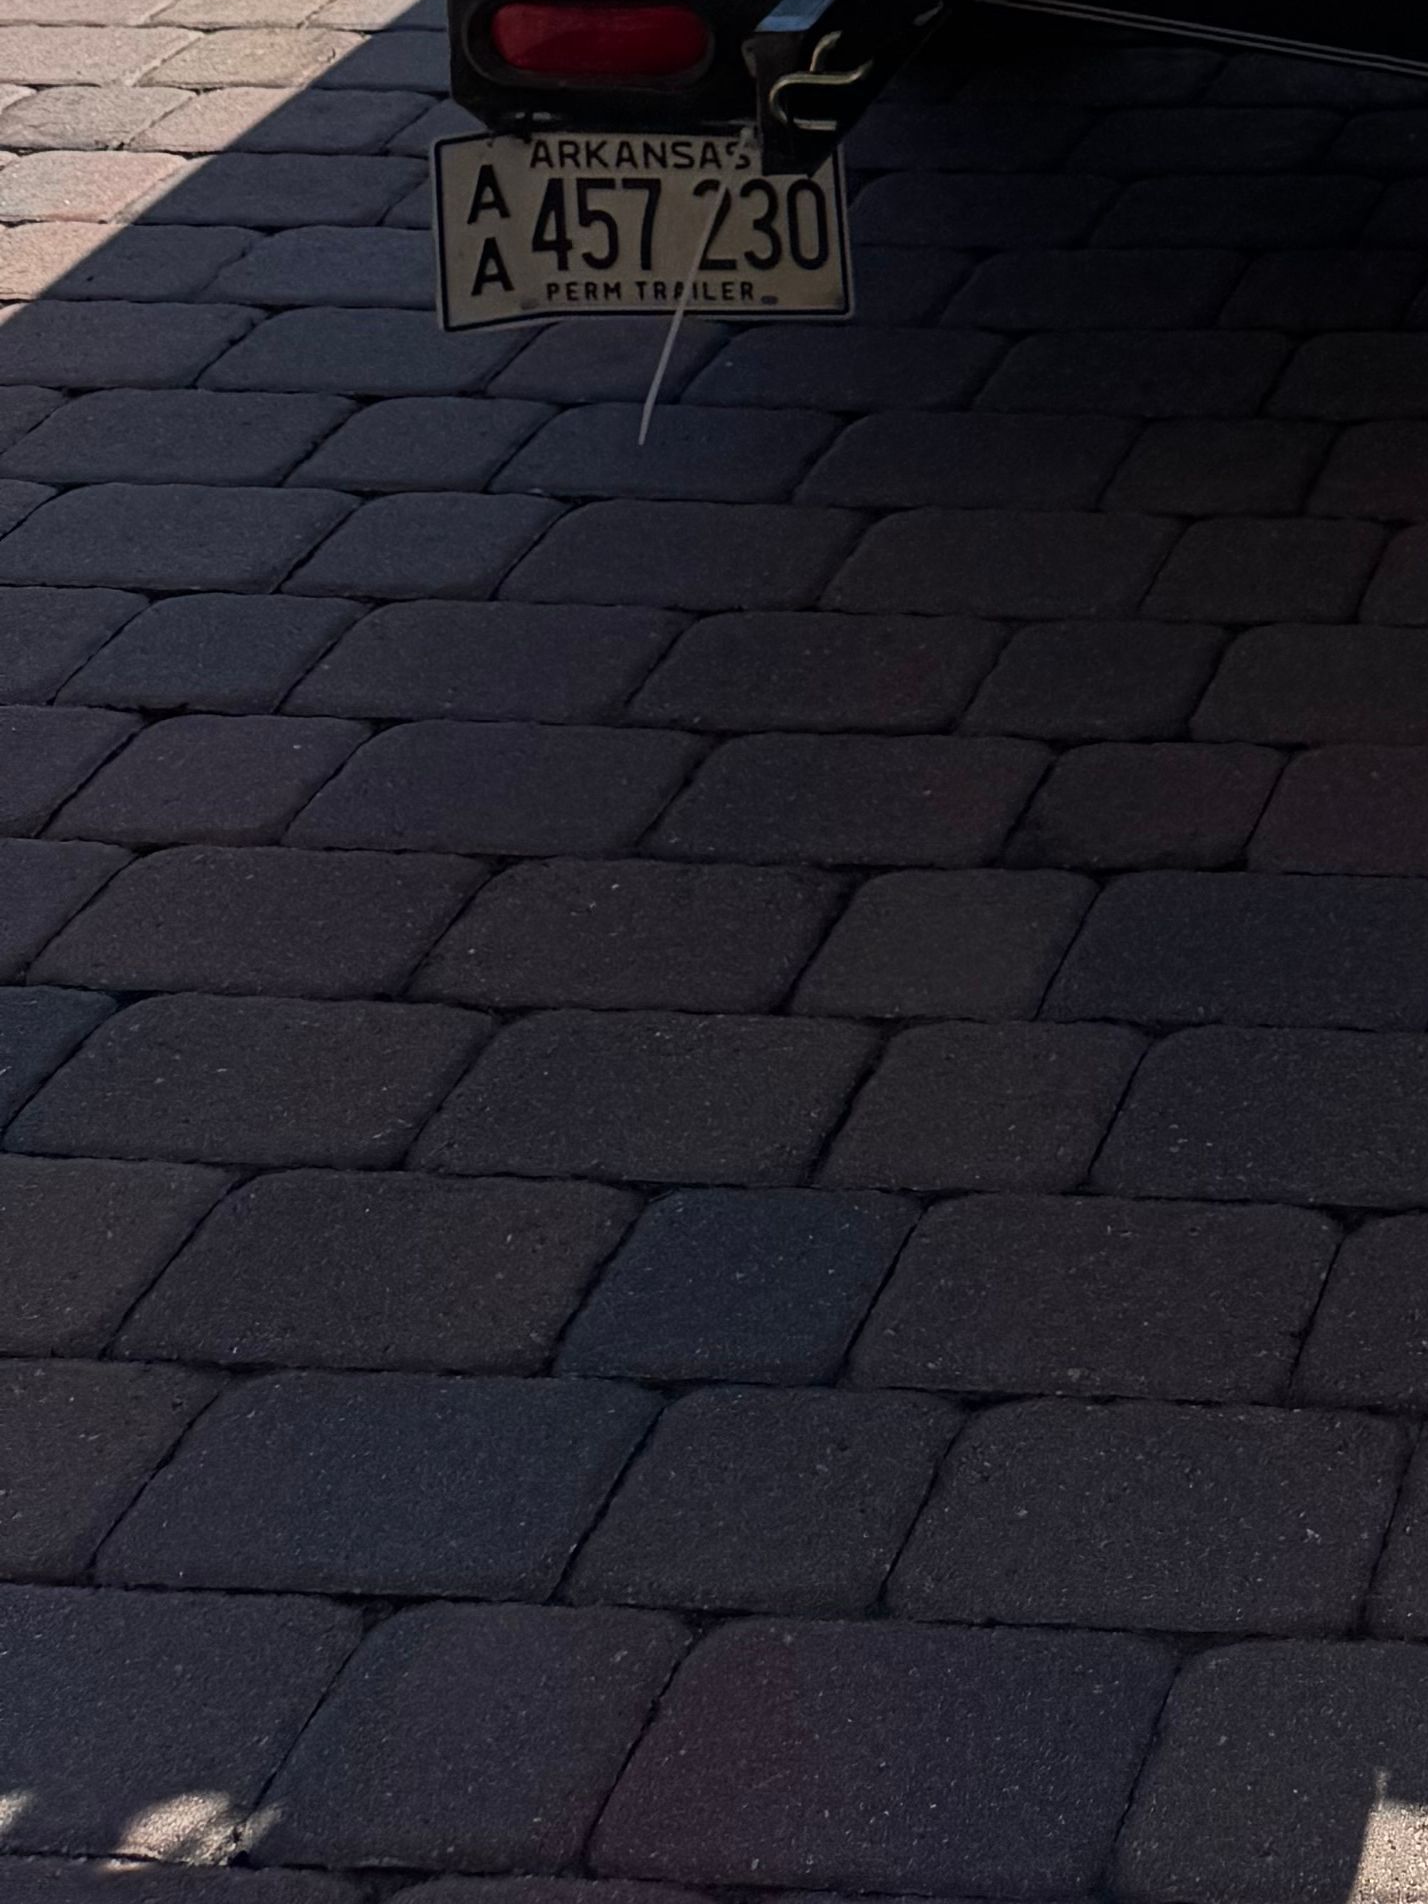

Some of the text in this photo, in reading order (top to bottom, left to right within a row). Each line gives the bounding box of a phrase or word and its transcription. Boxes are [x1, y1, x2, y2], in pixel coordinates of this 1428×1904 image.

[529, 140, 752, 170] ARKANSAS
[466, 164, 512, 225] A
[531, 177, 830, 271] 457 230
[470, 236, 515, 297] A
[545, 280, 755, 302] PERM TRAILER
